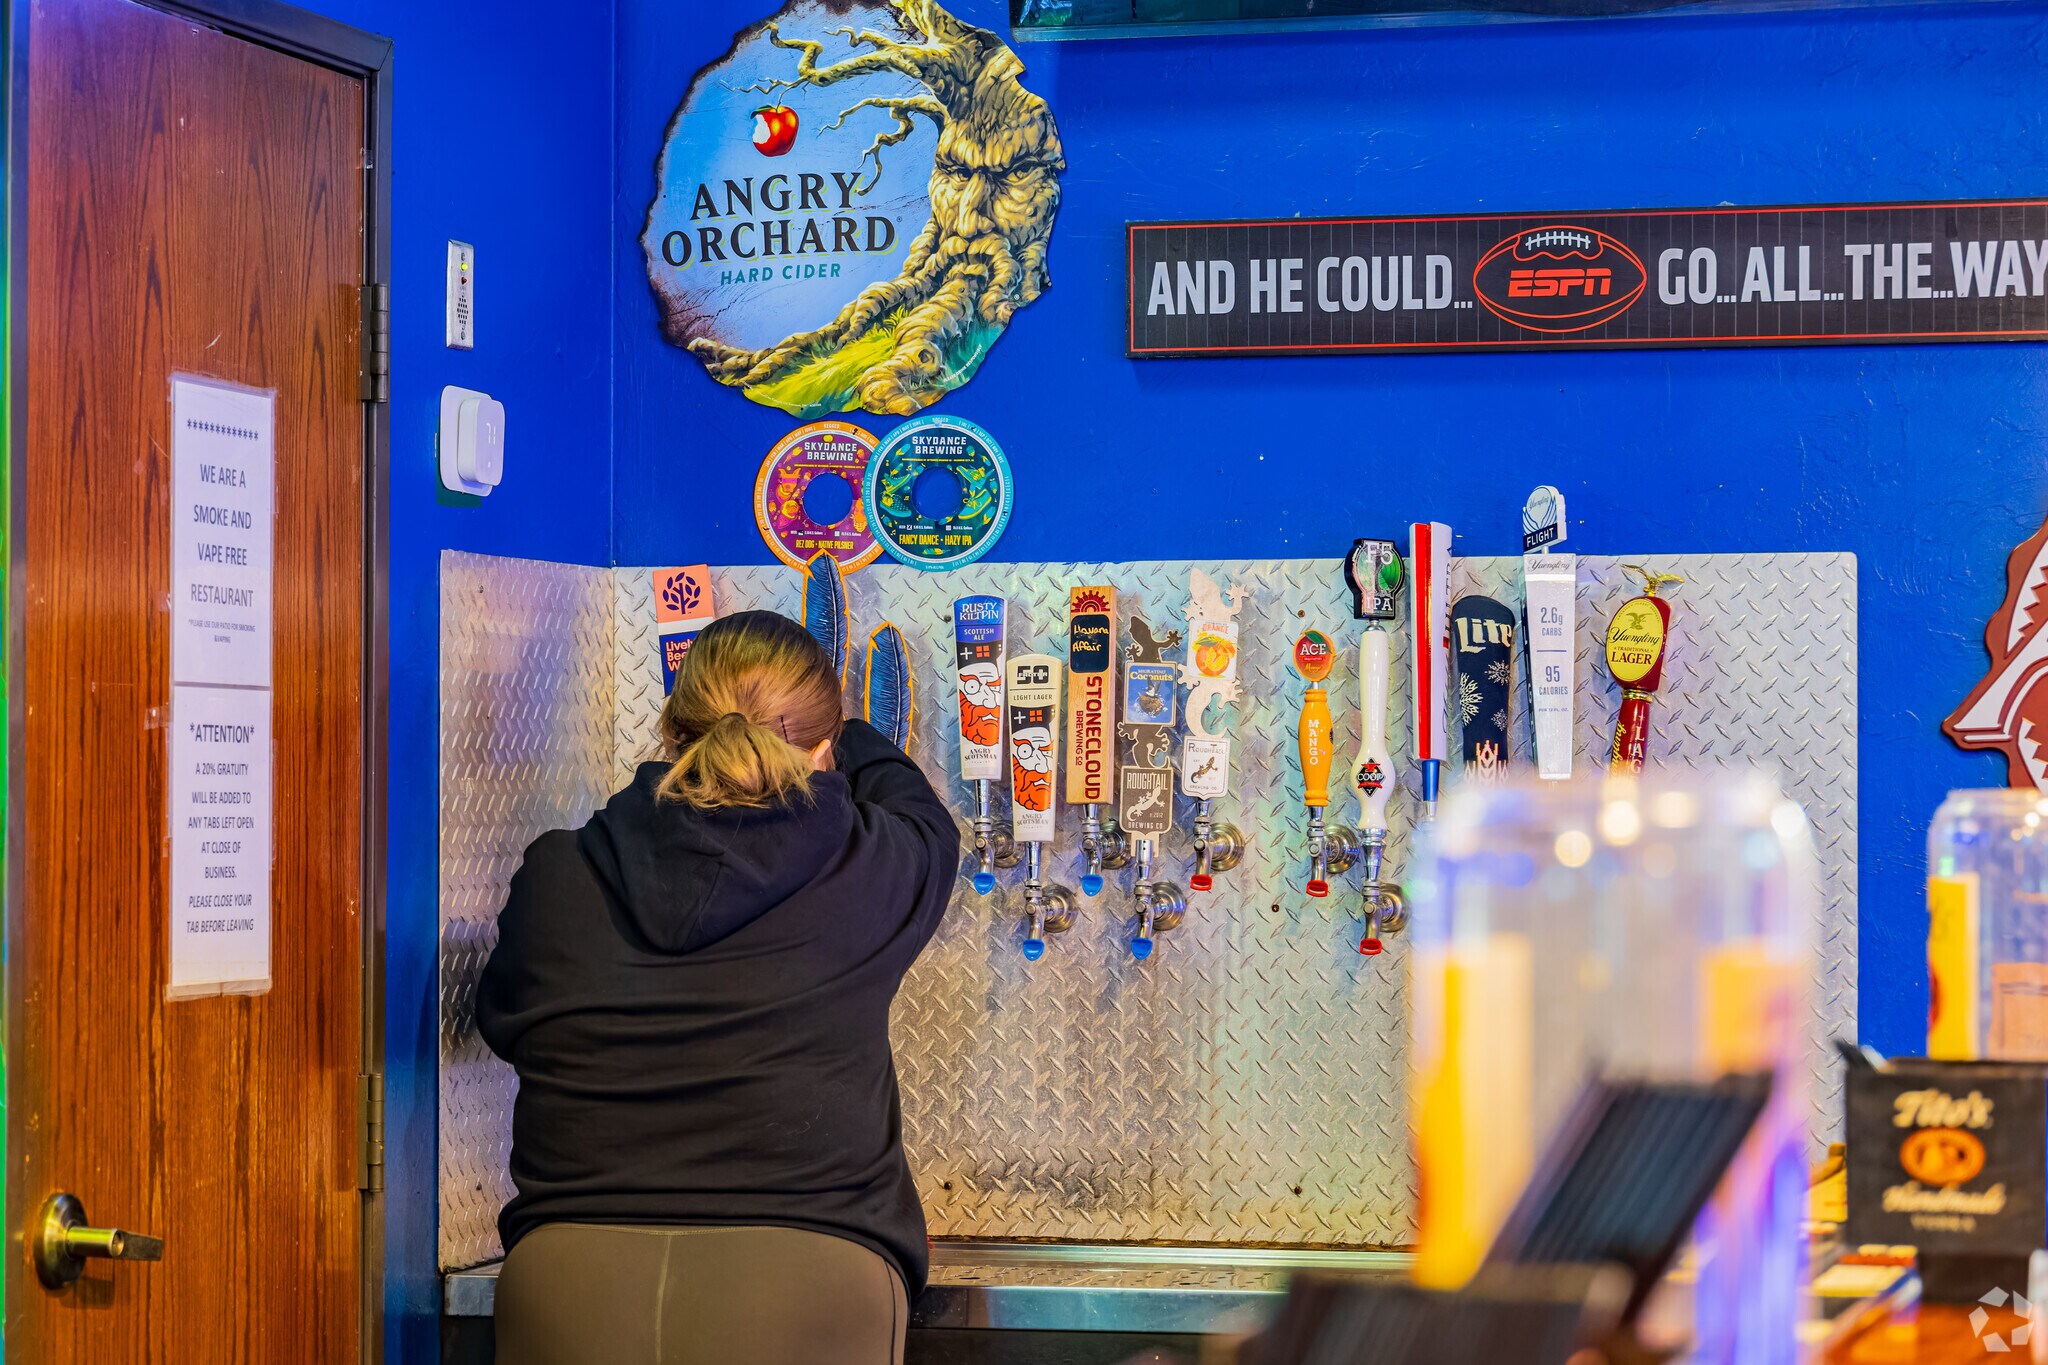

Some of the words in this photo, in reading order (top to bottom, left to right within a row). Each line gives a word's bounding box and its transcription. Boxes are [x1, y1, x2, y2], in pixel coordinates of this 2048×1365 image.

[690, 172, 862, 221] ANGRY
[661, 216, 897, 267] ORCHARD
[720, 267, 774, 286] HARD
[782, 263, 841, 280] CIDER
[1950, 238, 2048, 298] WAY
[1147, 260, 1236, 316] AND
[1250, 258, 1304, 313] HE
[1317, 254, 1474, 313] COULD...
[1508, 268, 1612, 297] ESPN
[805, 442, 857, 452] SKYDANCE
[912, 436, 967, 445] SKYDANCE
[807, 452, 854, 461] BREWING
[915, 446, 963, 455] BREWING
[200, 464, 216, 484] WE
[218, 467, 237, 487] ARE
[239, 470, 246, 488] A
[193, 504, 228, 527] SMOKE
[231, 510, 252, 530] AND
[899, 534, 918, 545] FANCY
[919, 534, 939, 546] DANCE
[945, 535, 961, 546] HAZY
[962, 535, 972, 546] IPA
[1526, 527, 1554, 548] FLIGHT
[197, 542, 223, 563] VAPE
[225, 547, 248, 566] FREE
[1366, 541, 1394, 565] F5
[1527, 559, 1573, 572] Yuengling
[190, 583, 254, 607] RESTAURANT
[962, 602, 997, 613] RUSTY
[1366, 596, 1393, 611] IPA
[960, 610, 999, 620] KILTPIN
[1540, 606, 1563, 625] 2.6g
[1455, 617, 1513, 653] Lite
[1541, 627, 1562, 637] CARBS
[1608, 627, 1660, 646] Yuengling
[1072, 641, 1102, 652] Affair
[1300, 643, 1327, 656] ACE
[1611, 651, 1652, 665] LAGER
[1017, 665, 1049, 684] 50
[1130, 672, 1173, 681] Coconuts
[1545, 666, 1560, 683] 95
[1538, 686, 1568, 696] CALORIES
[1085, 676, 1103, 800] STONECLOUD
[1308, 719, 1320, 766] MANGO
[964, 753, 997, 761] SCOTSMAN
[195, 763, 201, 775] A
[202, 763, 215, 775] 20%
[217, 763, 249, 776] GRATUITY
[1126, 772, 1168, 790] ROUGHTAIL
[191, 791, 208, 804] WILL
[209, 791, 218, 804] BE
[219, 791, 241, 804] ADDED
[242, 792, 252, 804] TO
[188, 816, 202, 829] ANY
[203, 816, 220, 829] TABS
[221, 816, 236, 829] LEFT
[236, 816, 255, 829] OPEN
[1127, 821, 1154, 829] BREWING
[201, 841, 210, 854] AT
[211, 841, 231, 854] CLOSE
[232, 841, 242, 854] OF
[204, 866, 237, 879] BUSINESS.
[189, 895, 213, 908] PLEASE
[213, 894, 233, 907] CLOSE
[234, 894, 253, 906] YOUR
[186, 920, 200, 933] TAB
[200, 919, 226, 933] BEFORE
[226, 918, 254, 932] LEAVING
